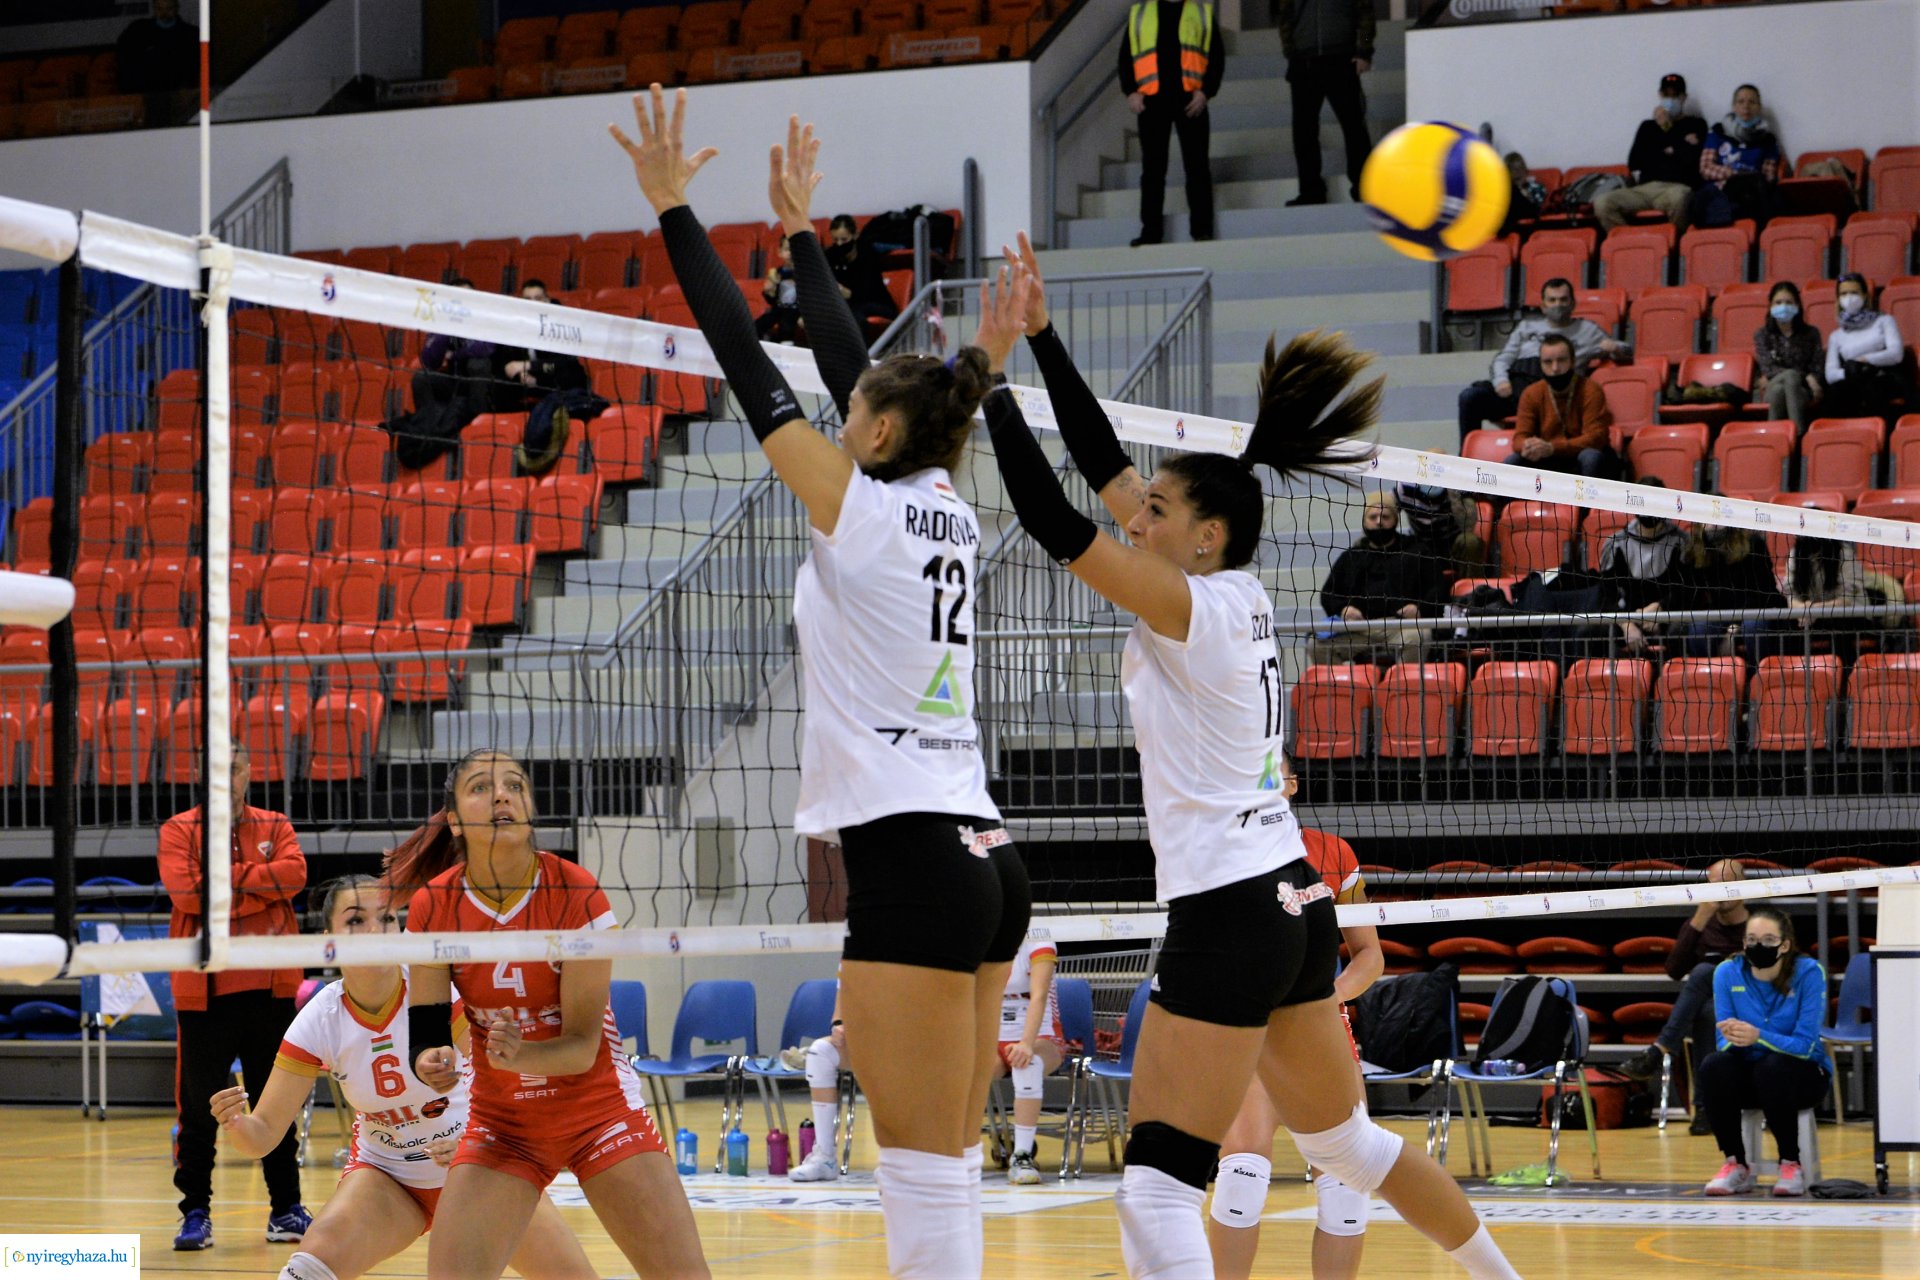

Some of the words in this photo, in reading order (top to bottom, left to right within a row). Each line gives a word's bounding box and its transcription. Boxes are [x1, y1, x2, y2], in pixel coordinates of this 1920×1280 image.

[538, 312, 583, 345] FATUM
[922, 555, 968, 646] 12
[1259, 656, 1281, 739] 17
[433, 939, 471, 960] FATUM
[759, 931, 792, 950] FATUM
[492, 960, 527, 998] 4
[371, 1053, 407, 1099] 6
[514, 1088, 558, 1100] SEAT
[379, 1134, 428, 1150] Miskolc
[431, 1121, 462, 1142] Autó
[588, 1131, 646, 1162] SEAT
